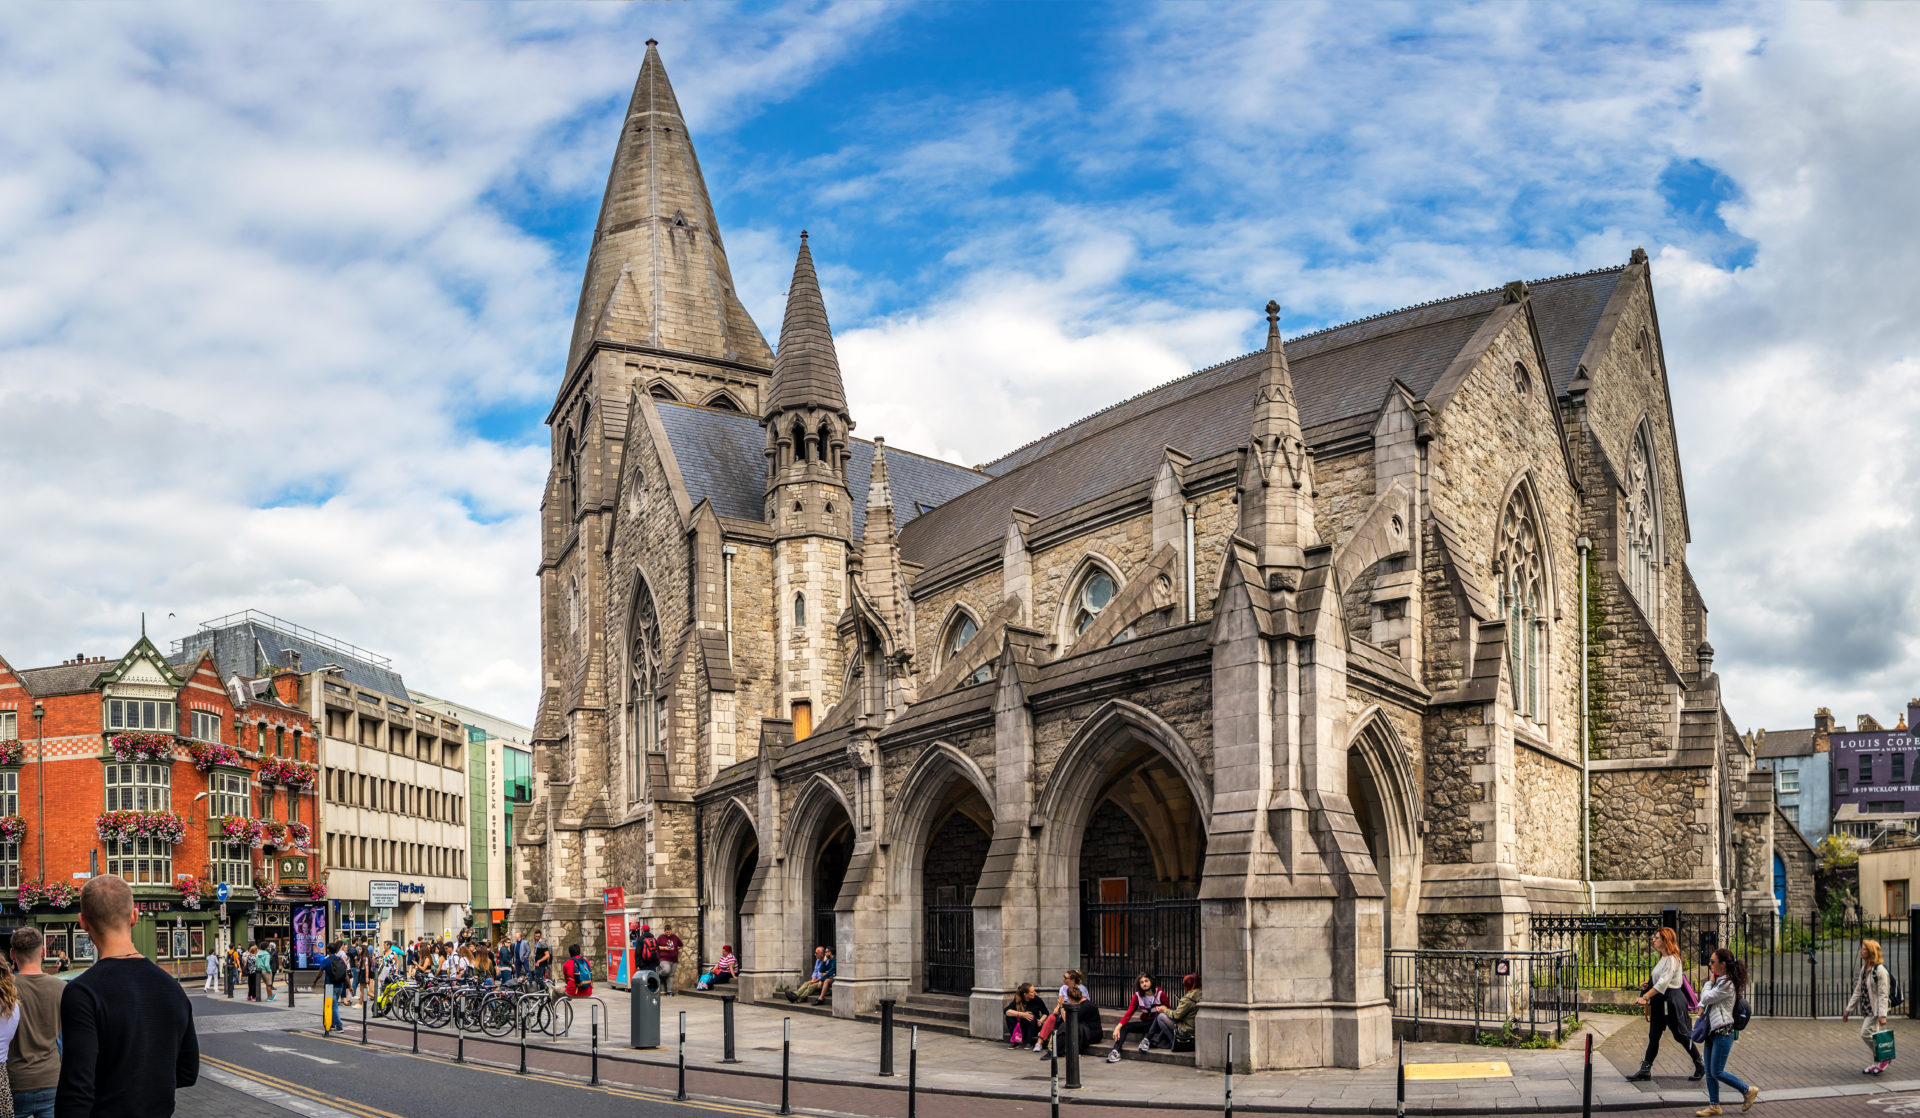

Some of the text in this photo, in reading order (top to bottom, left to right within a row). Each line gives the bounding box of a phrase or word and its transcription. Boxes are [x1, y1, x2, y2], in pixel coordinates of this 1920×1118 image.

[1840, 737, 1920, 748] LOUIS COPE
[410, 882, 425, 893] Bank
